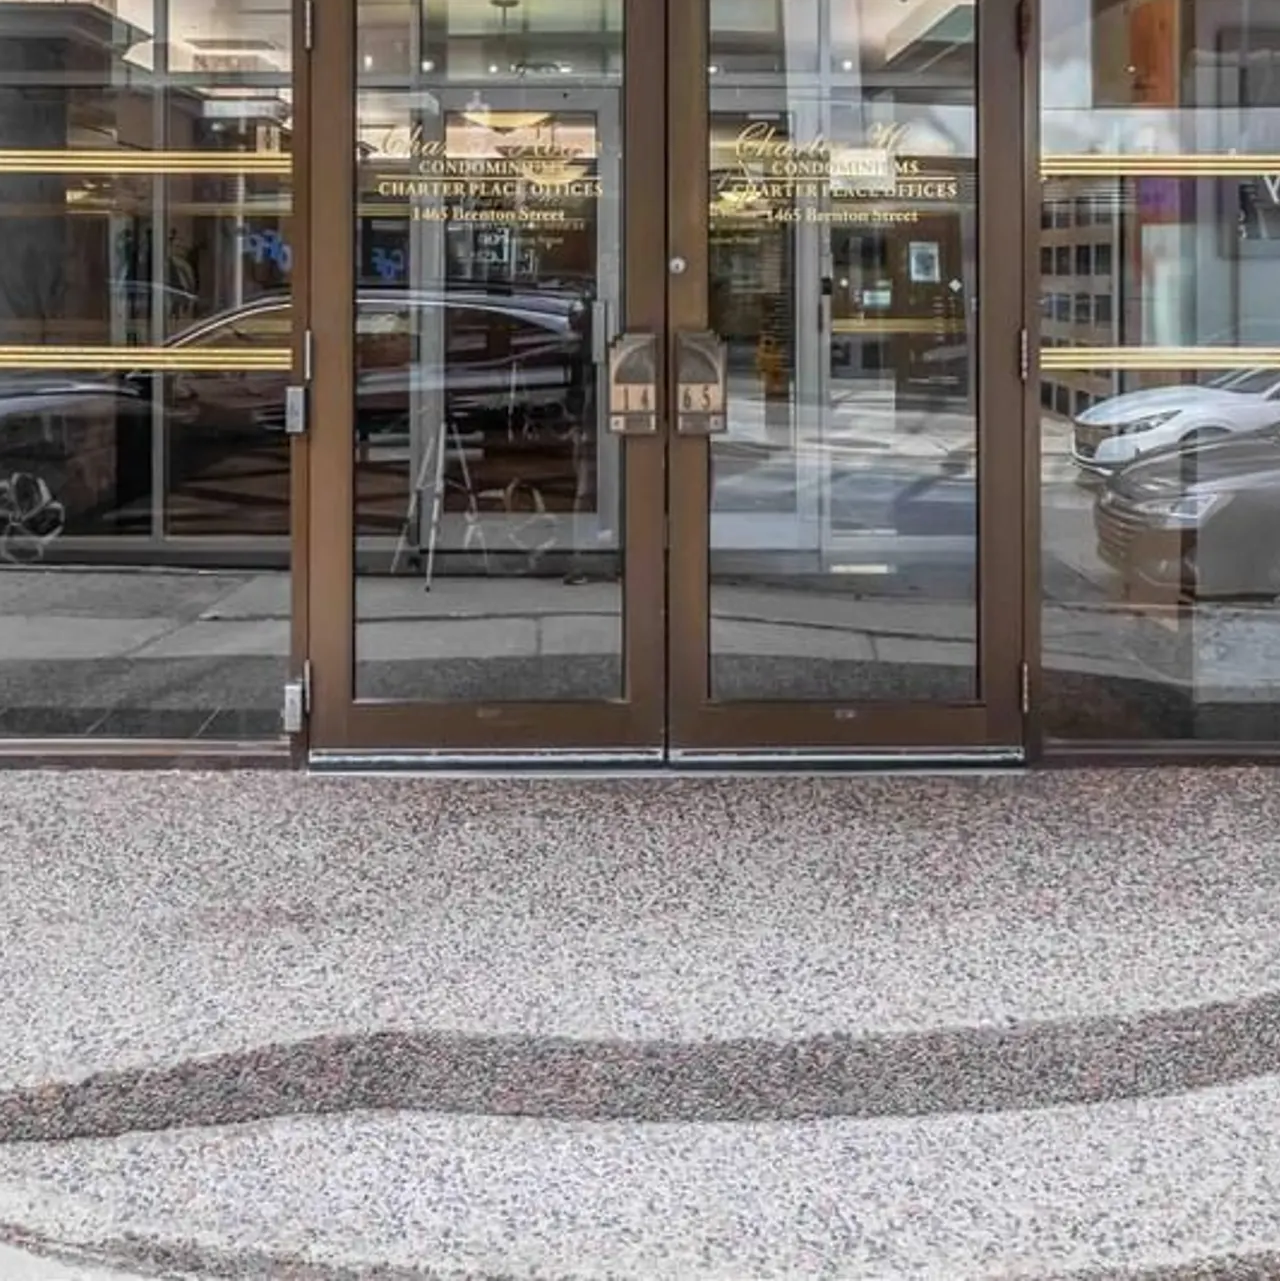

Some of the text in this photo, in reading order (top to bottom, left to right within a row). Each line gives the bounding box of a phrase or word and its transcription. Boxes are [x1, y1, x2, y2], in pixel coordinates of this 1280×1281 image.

[377, 181, 465, 197] CHARTER
[531, 181, 604, 197] OFFICES
[882, 183, 958, 198] OFFICES
[413, 208, 448, 221] 1465
[520, 207, 565, 221] Street
[766, 207, 801, 221] 1465
[872, 207, 920, 222] Street
